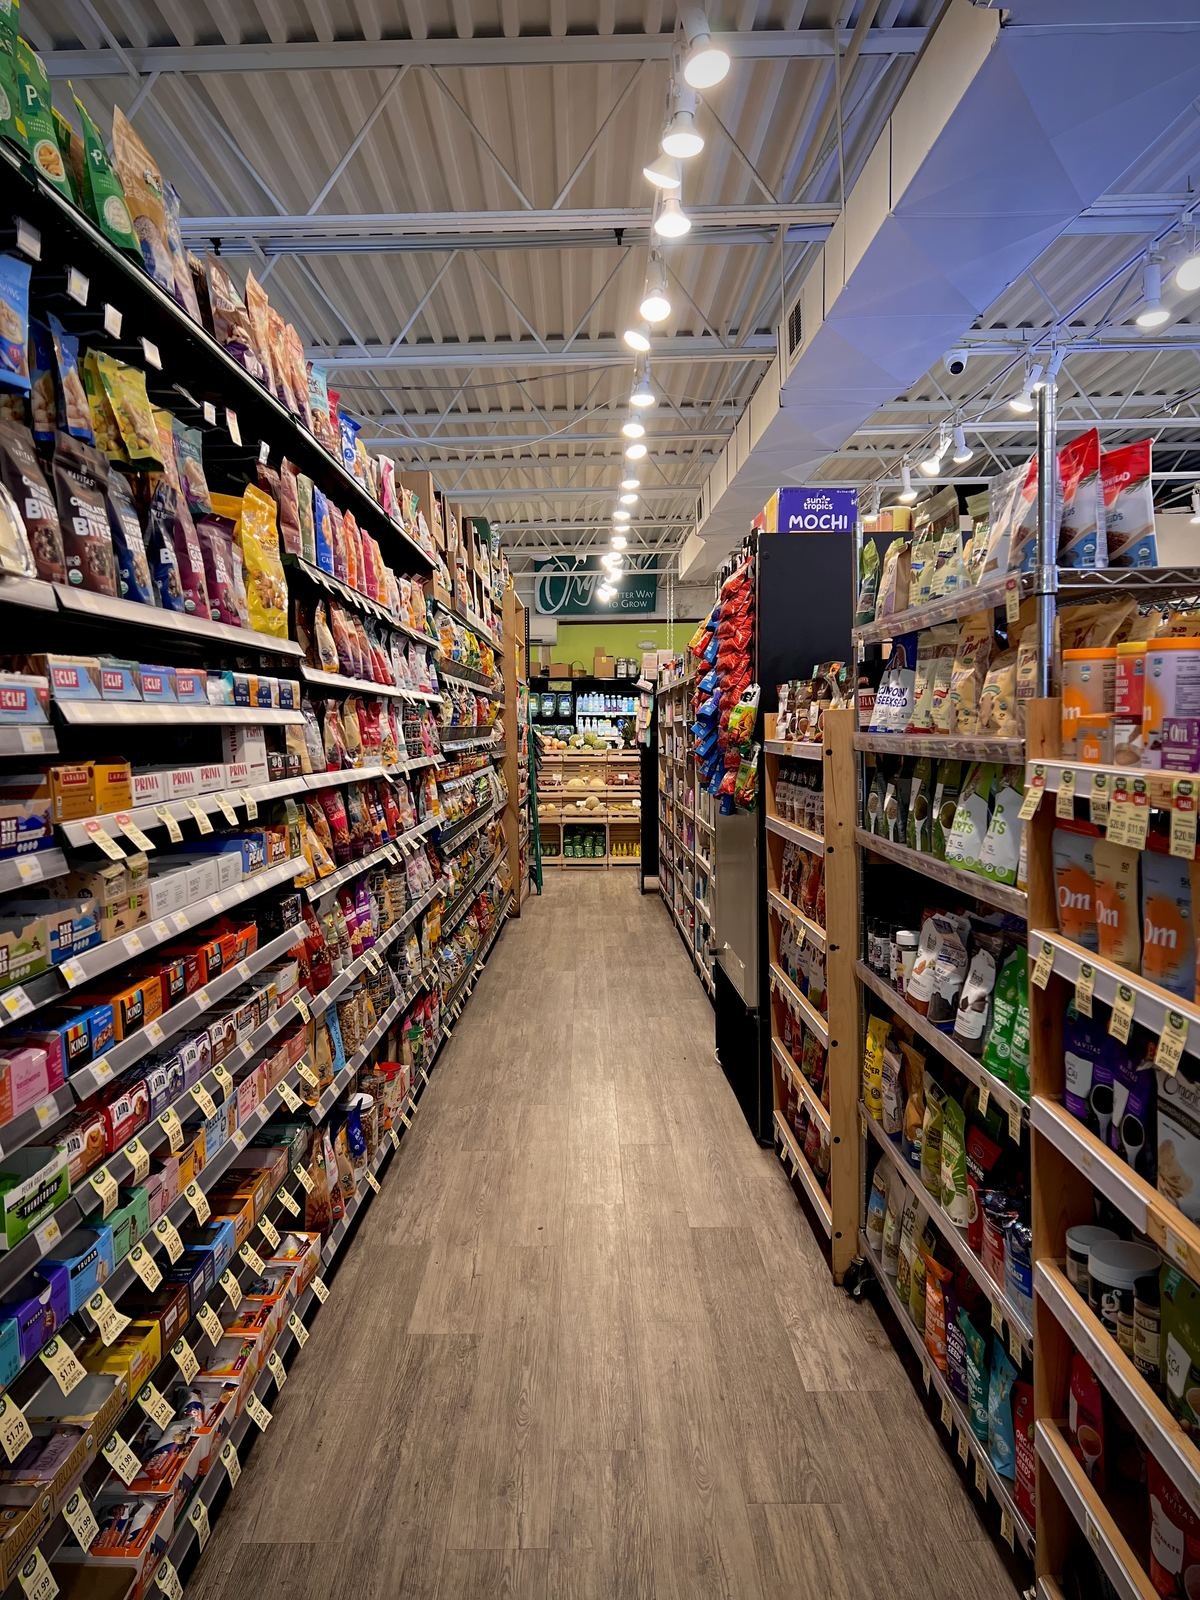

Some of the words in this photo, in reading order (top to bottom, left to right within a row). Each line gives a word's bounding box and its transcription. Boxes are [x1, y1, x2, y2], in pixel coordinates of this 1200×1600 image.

[803, 502, 833, 512] tropics
[789, 514, 847, 530] MOCHI
[621, 600, 647, 608] GROW
[60, 669, 77, 685] CLIF
[107, 672, 122, 687] CLIF
[148, 676, 161, 690] CLIF
[181, 680, 194, 693] CLIF
[5, 689, 26, 707] CLIF
[172, 771, 195, 786] PRIMA
[200, 767, 221, 780] PRIMA
[229, 764, 248, 777] PRIMA
[135, 775, 159, 792] PRIMA
[1177, 800, 1192, 809] SALE
[272, 839, 286, 855] PEAK
[1059, 885, 1091, 911] Om
[209, 953, 221, 966] KIND
[127, 1003, 142, 1019] KIND
[70, 1034, 88, 1052] KIND
[116, 1101, 129, 1121] LAIRD
[23, 1181, 58, 1216] THUNDERBIRD
[169, 1236, 180, 1251] $1.79
[77, 1249, 98, 1272] TRUBAR
[144, 1263, 157, 1281] $1.79
[102, 1312, 117, 1333] $1.79
[60, 1360, 76, 1381] $1.79
[184, 1355, 195, 1373] $2.29
[154, 1403, 168, 1421] $2.29
[6, 1421, 25, 1446] $1.79
[118, 1453, 133, 1474] $1.99
[77, 1515, 92, 1539] $1.99
[33, 1576, 51, 1600] $1.99
